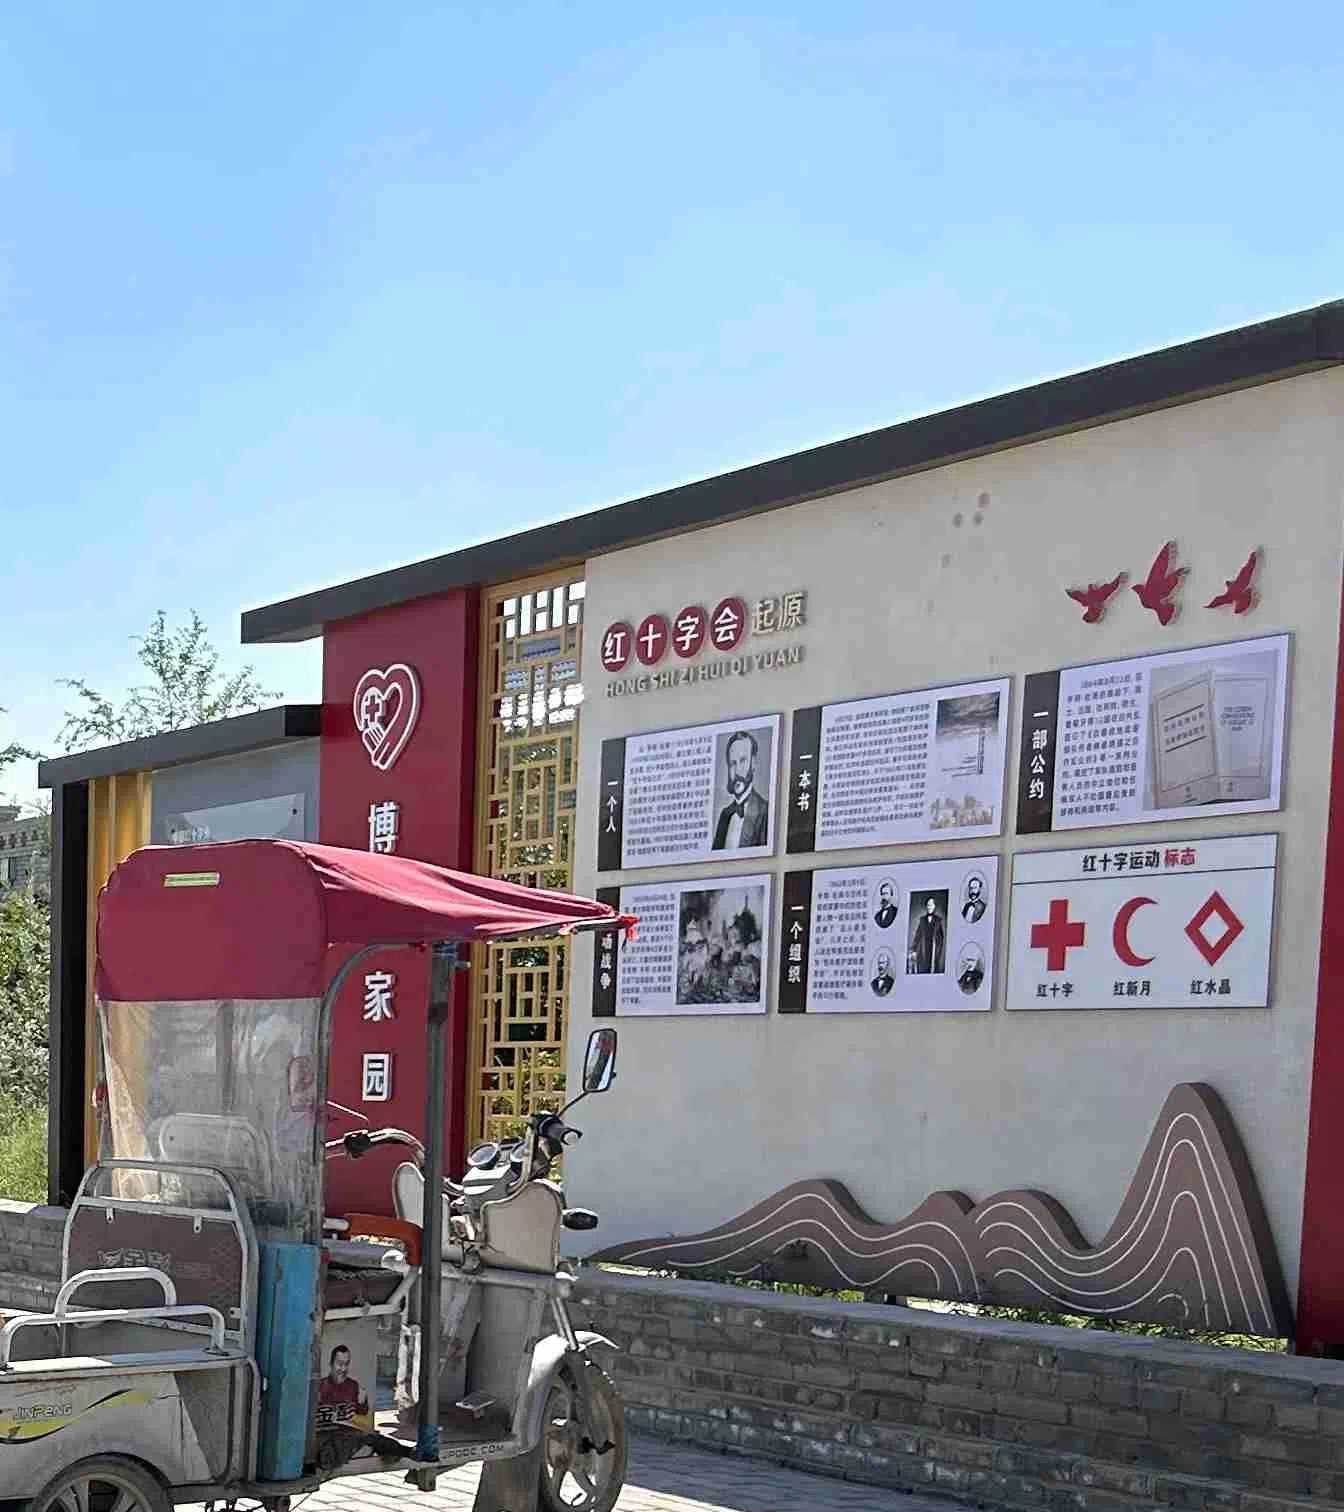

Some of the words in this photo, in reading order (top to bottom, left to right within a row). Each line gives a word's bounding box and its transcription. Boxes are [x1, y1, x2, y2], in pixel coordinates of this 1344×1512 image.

[603, 592, 803, 665] 红十字会起源
[606, 676, 649, 697] HONG
[650, 666, 676, 689] SHI
[678, 664, 695, 684] ZI
[699, 656, 727, 679] HUI
[731, 654, 748, 675] QI
[752, 646, 802, 669] YUAN
[1029, 711, 1049, 800] 一部公约
[606, 781, 618, 833] 一个人
[797, 754, 812, 812] 一本书
[1082, 848, 1197, 873] 红十字运动标志
[787, 905, 804, 984] 一个组织
[1036, 983, 1074, 998] 红十字
[1113, 980, 1152, 996] 红新月
[1190, 979, 1231, 995] 红水晶
